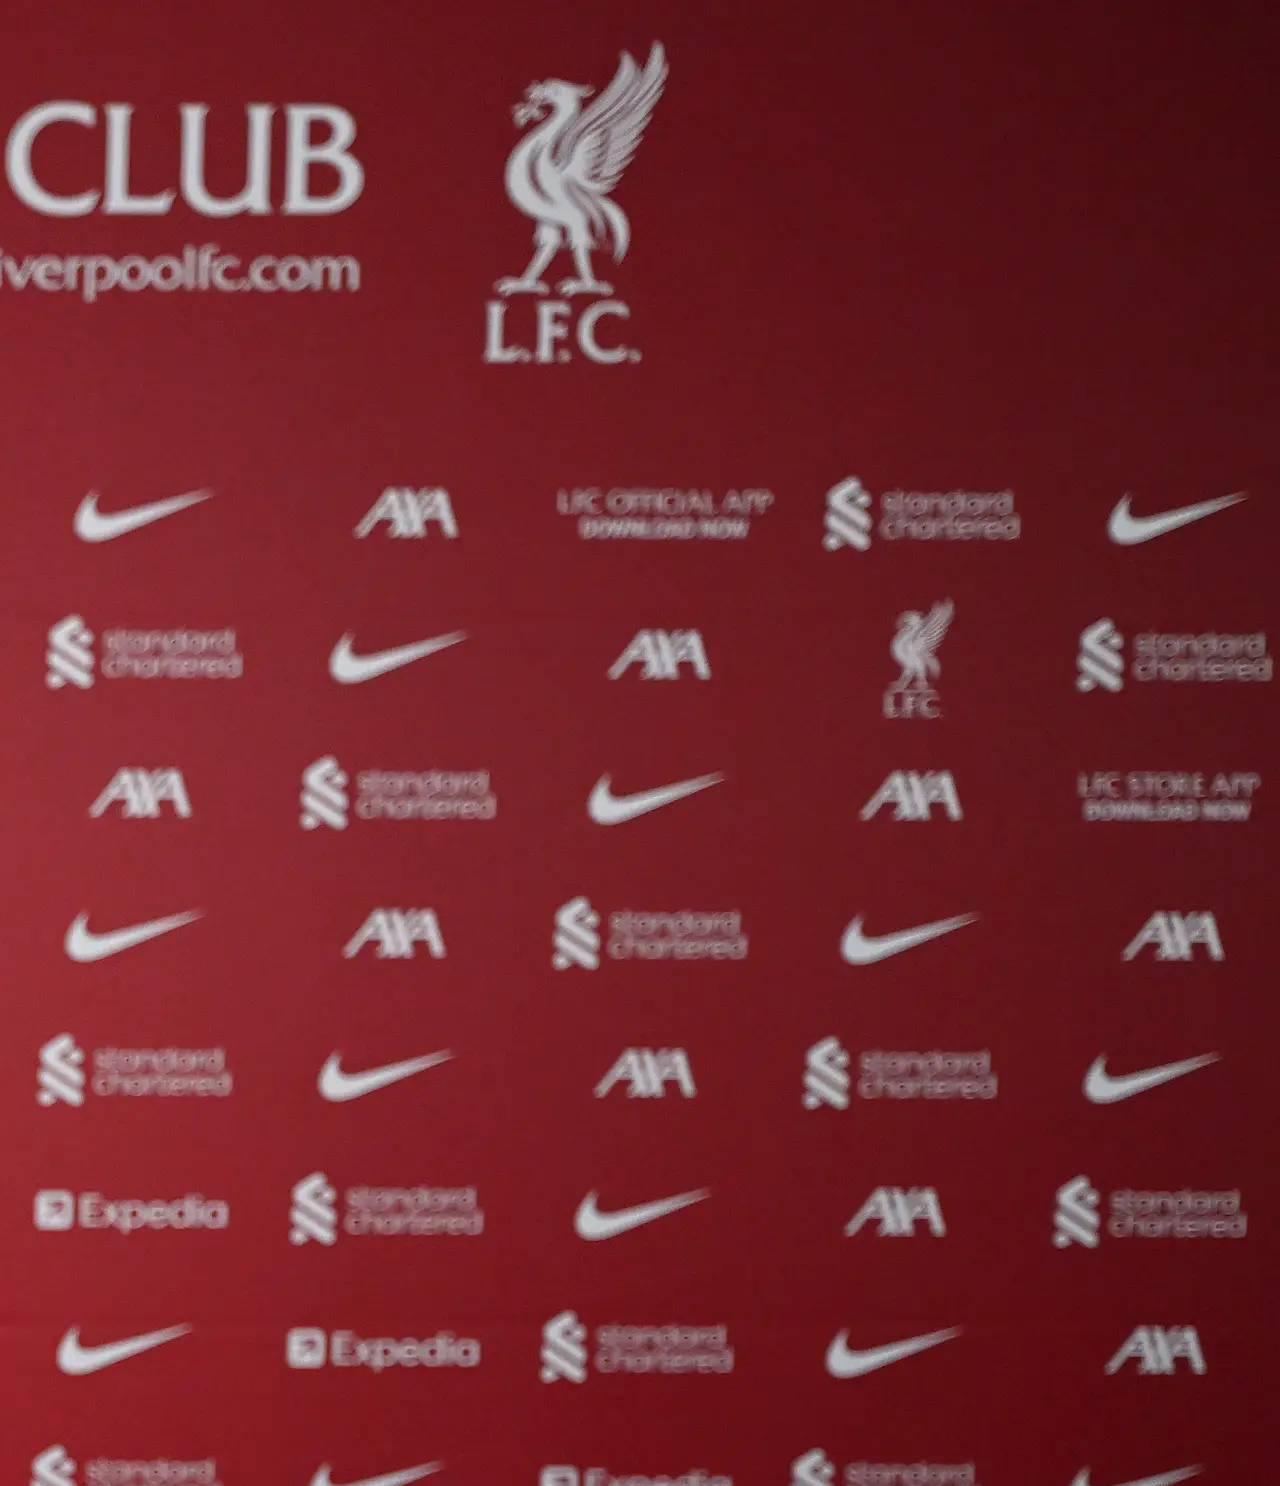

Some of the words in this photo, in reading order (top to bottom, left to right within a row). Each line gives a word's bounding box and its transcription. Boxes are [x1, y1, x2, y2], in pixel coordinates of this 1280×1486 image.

[5, 100, 365, 218] CLUB
[483, 298, 642, 364] L.F.C.
[354, 487, 458, 538] AXA
[608, 629, 711, 680] AXA
[89, 767, 192, 818] AXA
[860, 770, 963, 821] AXA
[343, 908, 446, 958] AXA
[1122, 911, 1224, 961] AXA
[594, 1048, 696, 1098] AXA
[80, 1193, 230, 1232] Expedia
[844, 1187, 946, 1237] AXA
[332, 1331, 482, 1370] Expedia
[1105, 1325, 1206, 1375] AXA
